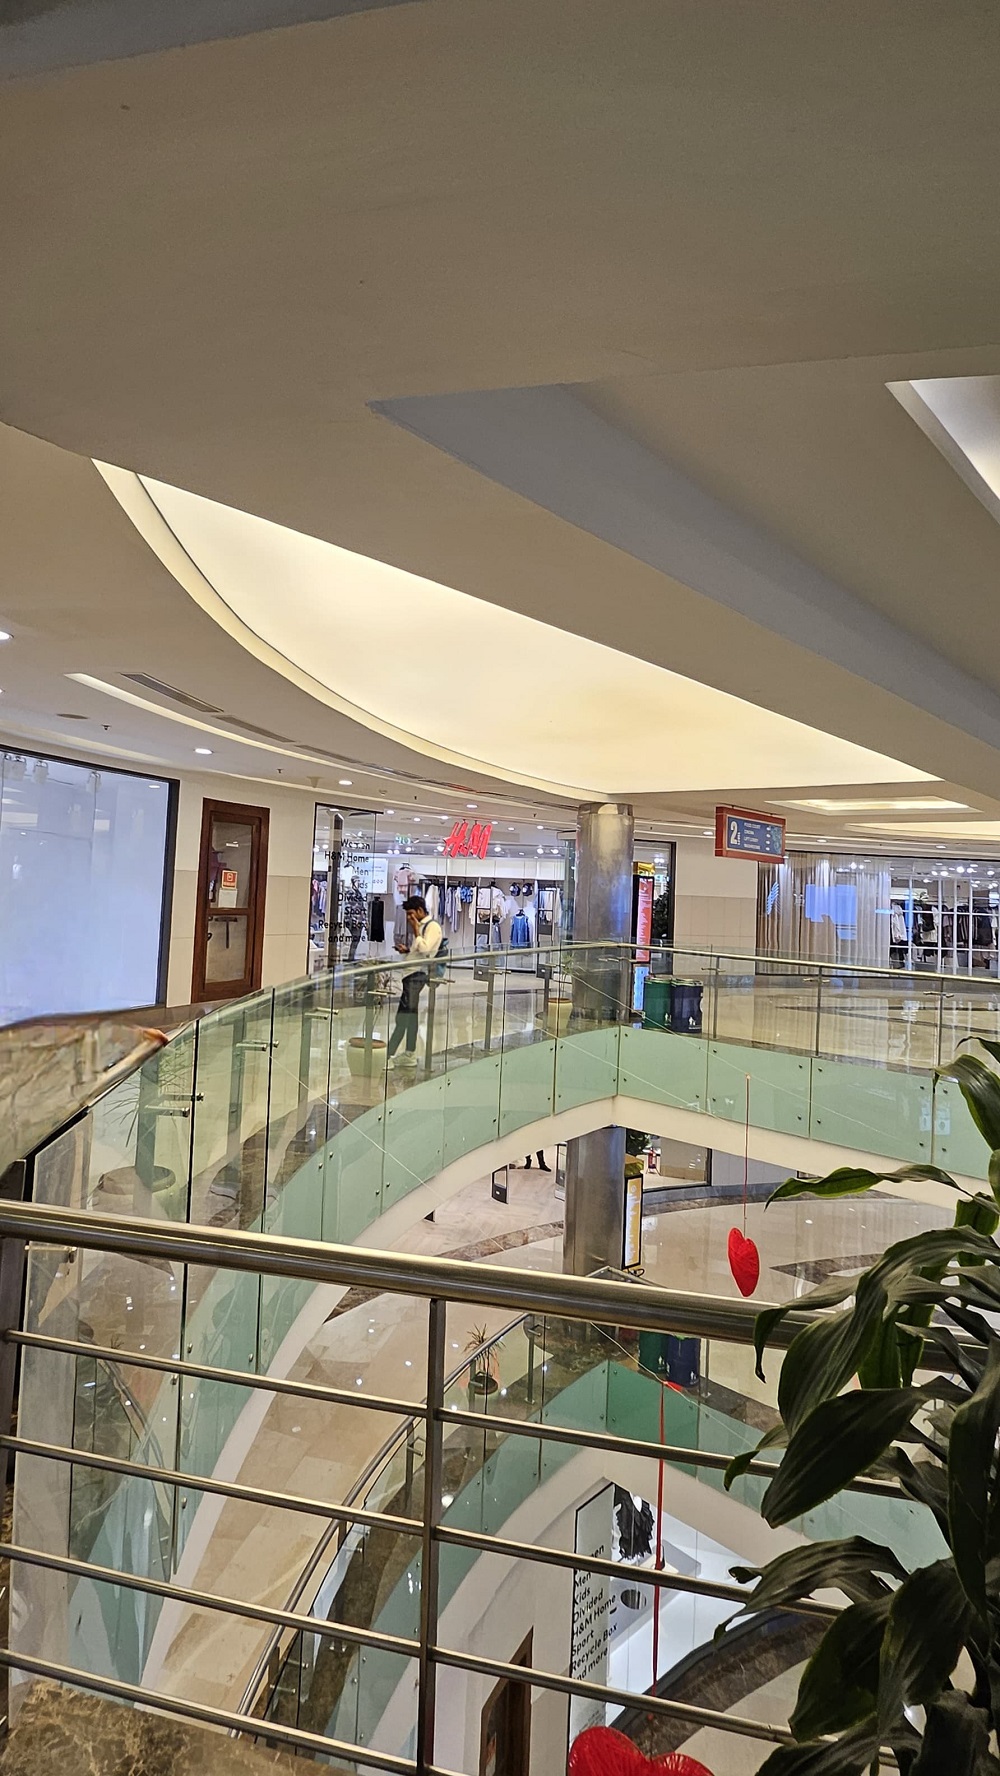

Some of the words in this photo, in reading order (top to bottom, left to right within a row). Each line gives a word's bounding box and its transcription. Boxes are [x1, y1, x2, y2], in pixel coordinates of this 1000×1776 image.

[443, 821, 492, 859] H&M
[731, 821, 737, 844] 2
[347, 852, 370, 863] Home
[593, 1594, 616, 1621] Home
[572, 1629, 594, 1657] Sport
[572, 1639, 602, 1671] Recycle
[603, 1622, 618, 1642] Box
[588, 1647, 608, 1672] more
